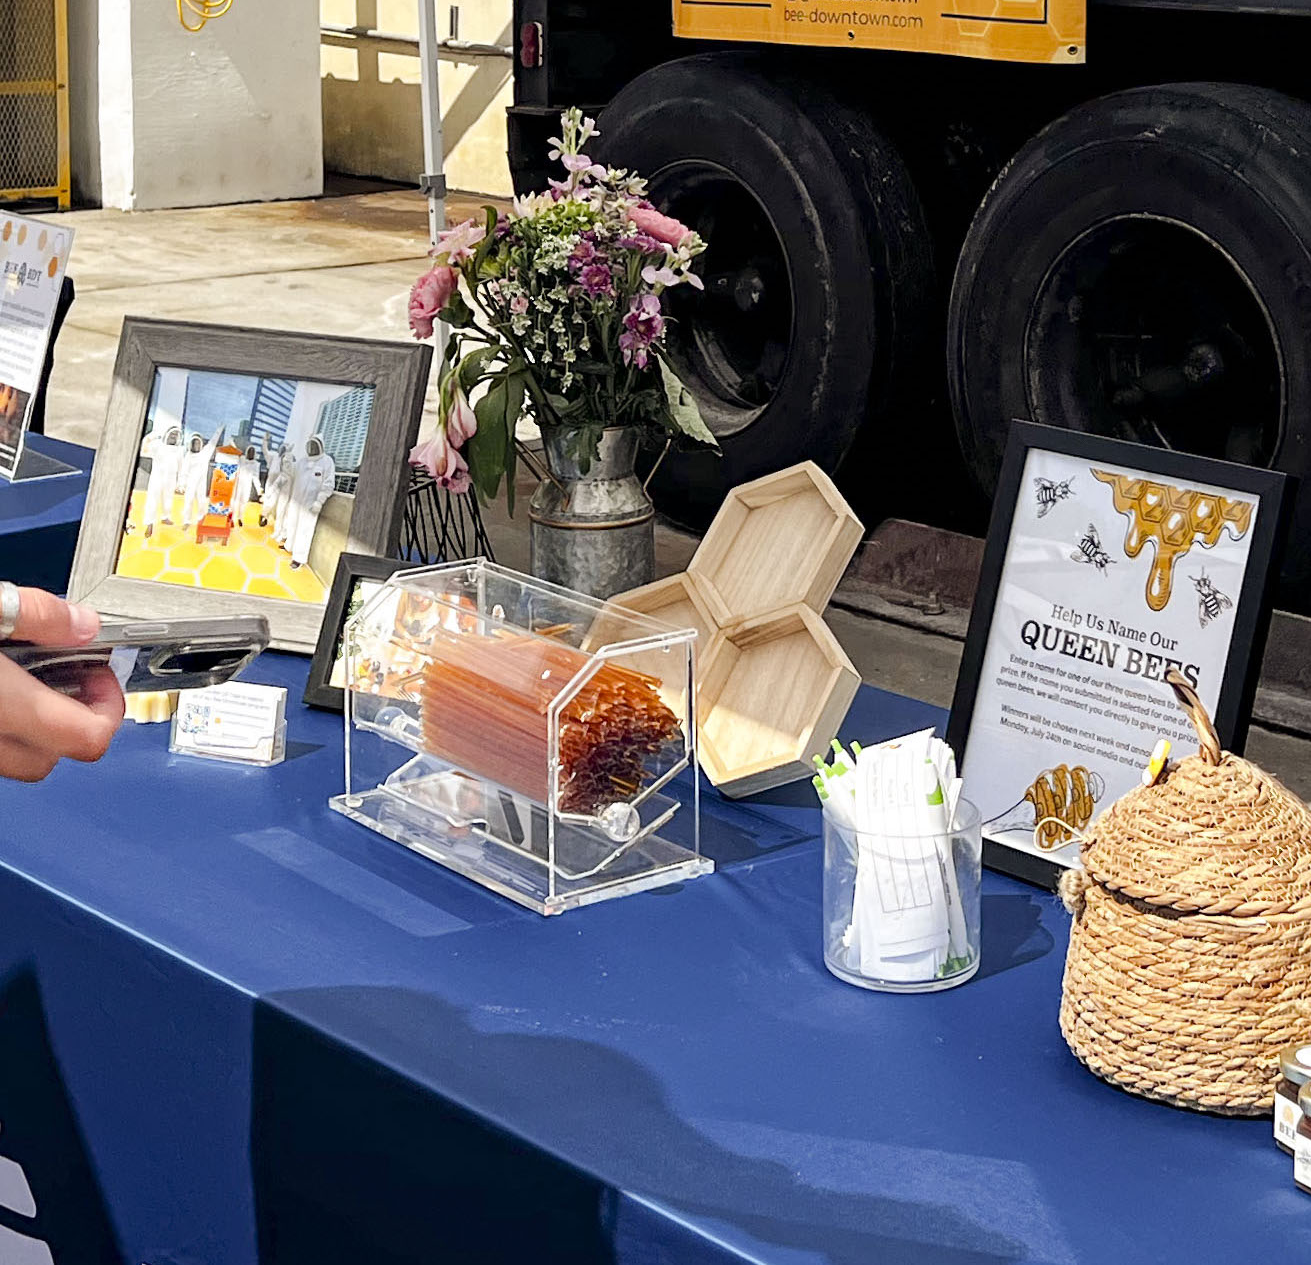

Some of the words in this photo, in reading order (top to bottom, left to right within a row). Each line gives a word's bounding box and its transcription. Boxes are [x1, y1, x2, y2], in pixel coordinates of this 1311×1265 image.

[784, 6, 923, 29] bee-downtown.com
[1021, 620, 1119, 667] QUEEN
[1051, 604, 1082, 628] Help
[1086, 613, 1104, 631] Us
[1107, 619, 1147, 642] Name
[1150, 631, 1178, 651] Our
[1056, 667, 1067, 677] for
[1067, 672, 1081, 682] one
[1081, 676, 1091, 684] of
